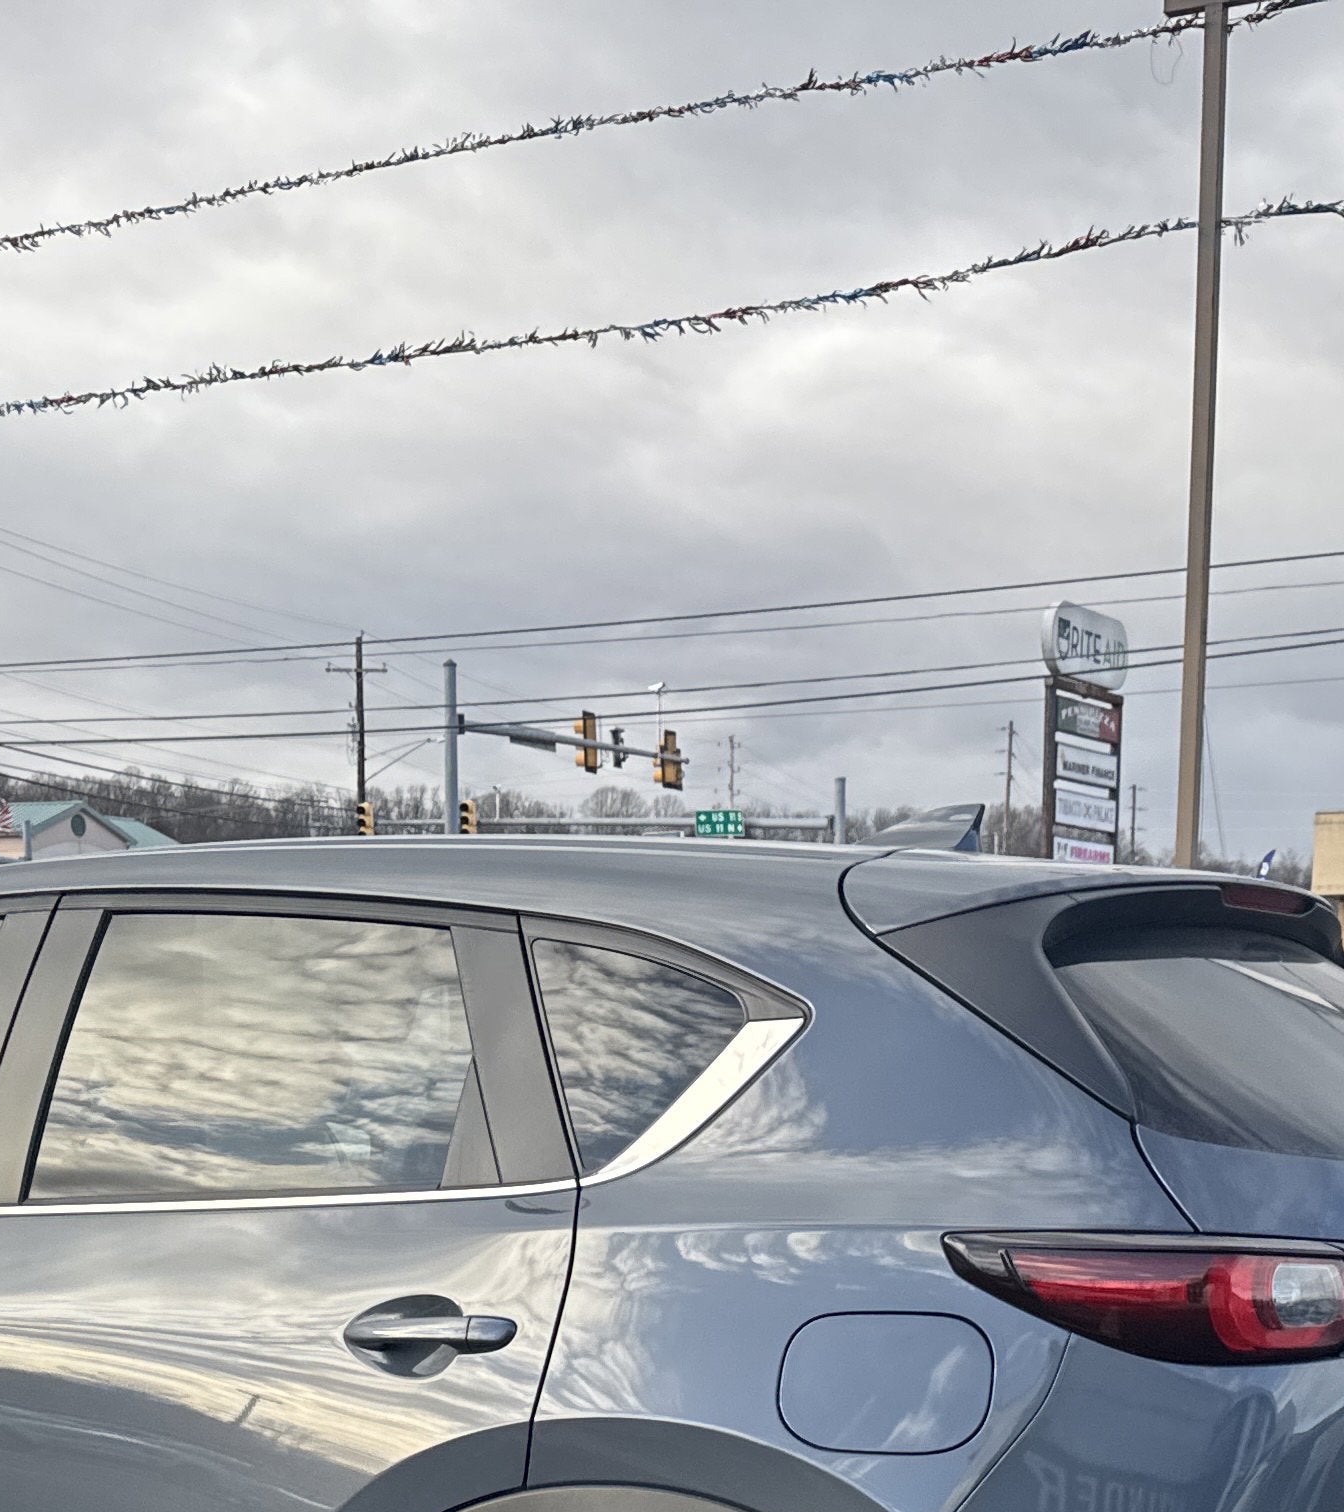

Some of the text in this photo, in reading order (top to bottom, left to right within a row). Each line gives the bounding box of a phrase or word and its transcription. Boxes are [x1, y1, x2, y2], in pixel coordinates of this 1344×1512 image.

[1071, 625, 1126, 668] RITE AID
[711, 812, 725, 822] US
[698, 823, 712, 833] US
[1070, 845, 1111, 863] FIREARMS
